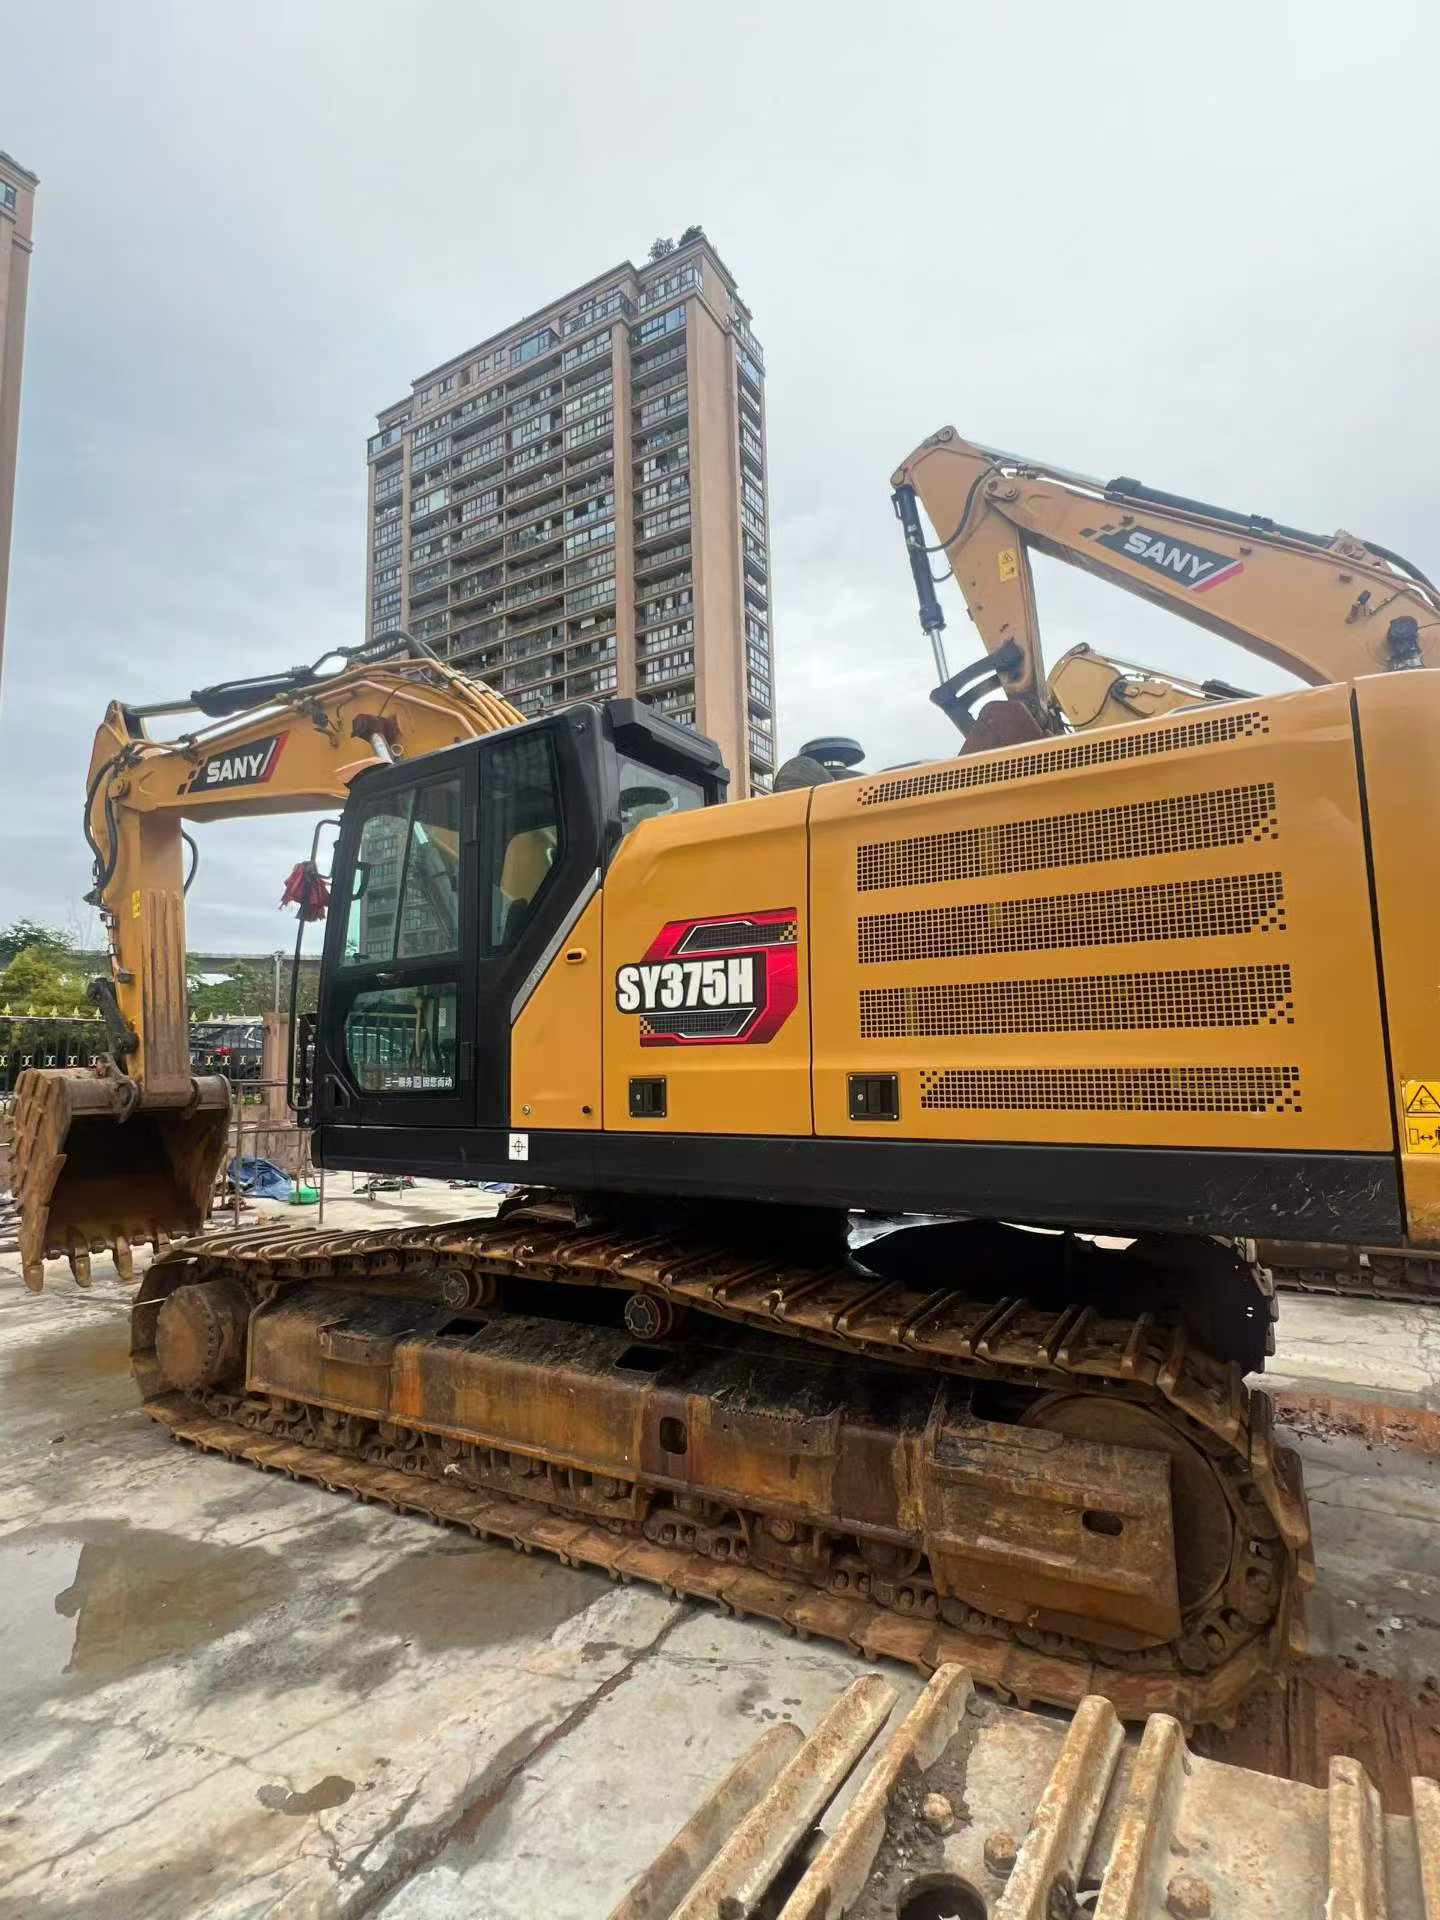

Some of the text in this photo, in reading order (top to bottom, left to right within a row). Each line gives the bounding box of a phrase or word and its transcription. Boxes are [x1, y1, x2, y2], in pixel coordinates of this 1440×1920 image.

[1123, 531, 1214, 579] SANY
[206, 753, 264, 783] SANY
[618, 957, 754, 1011] SY375H
